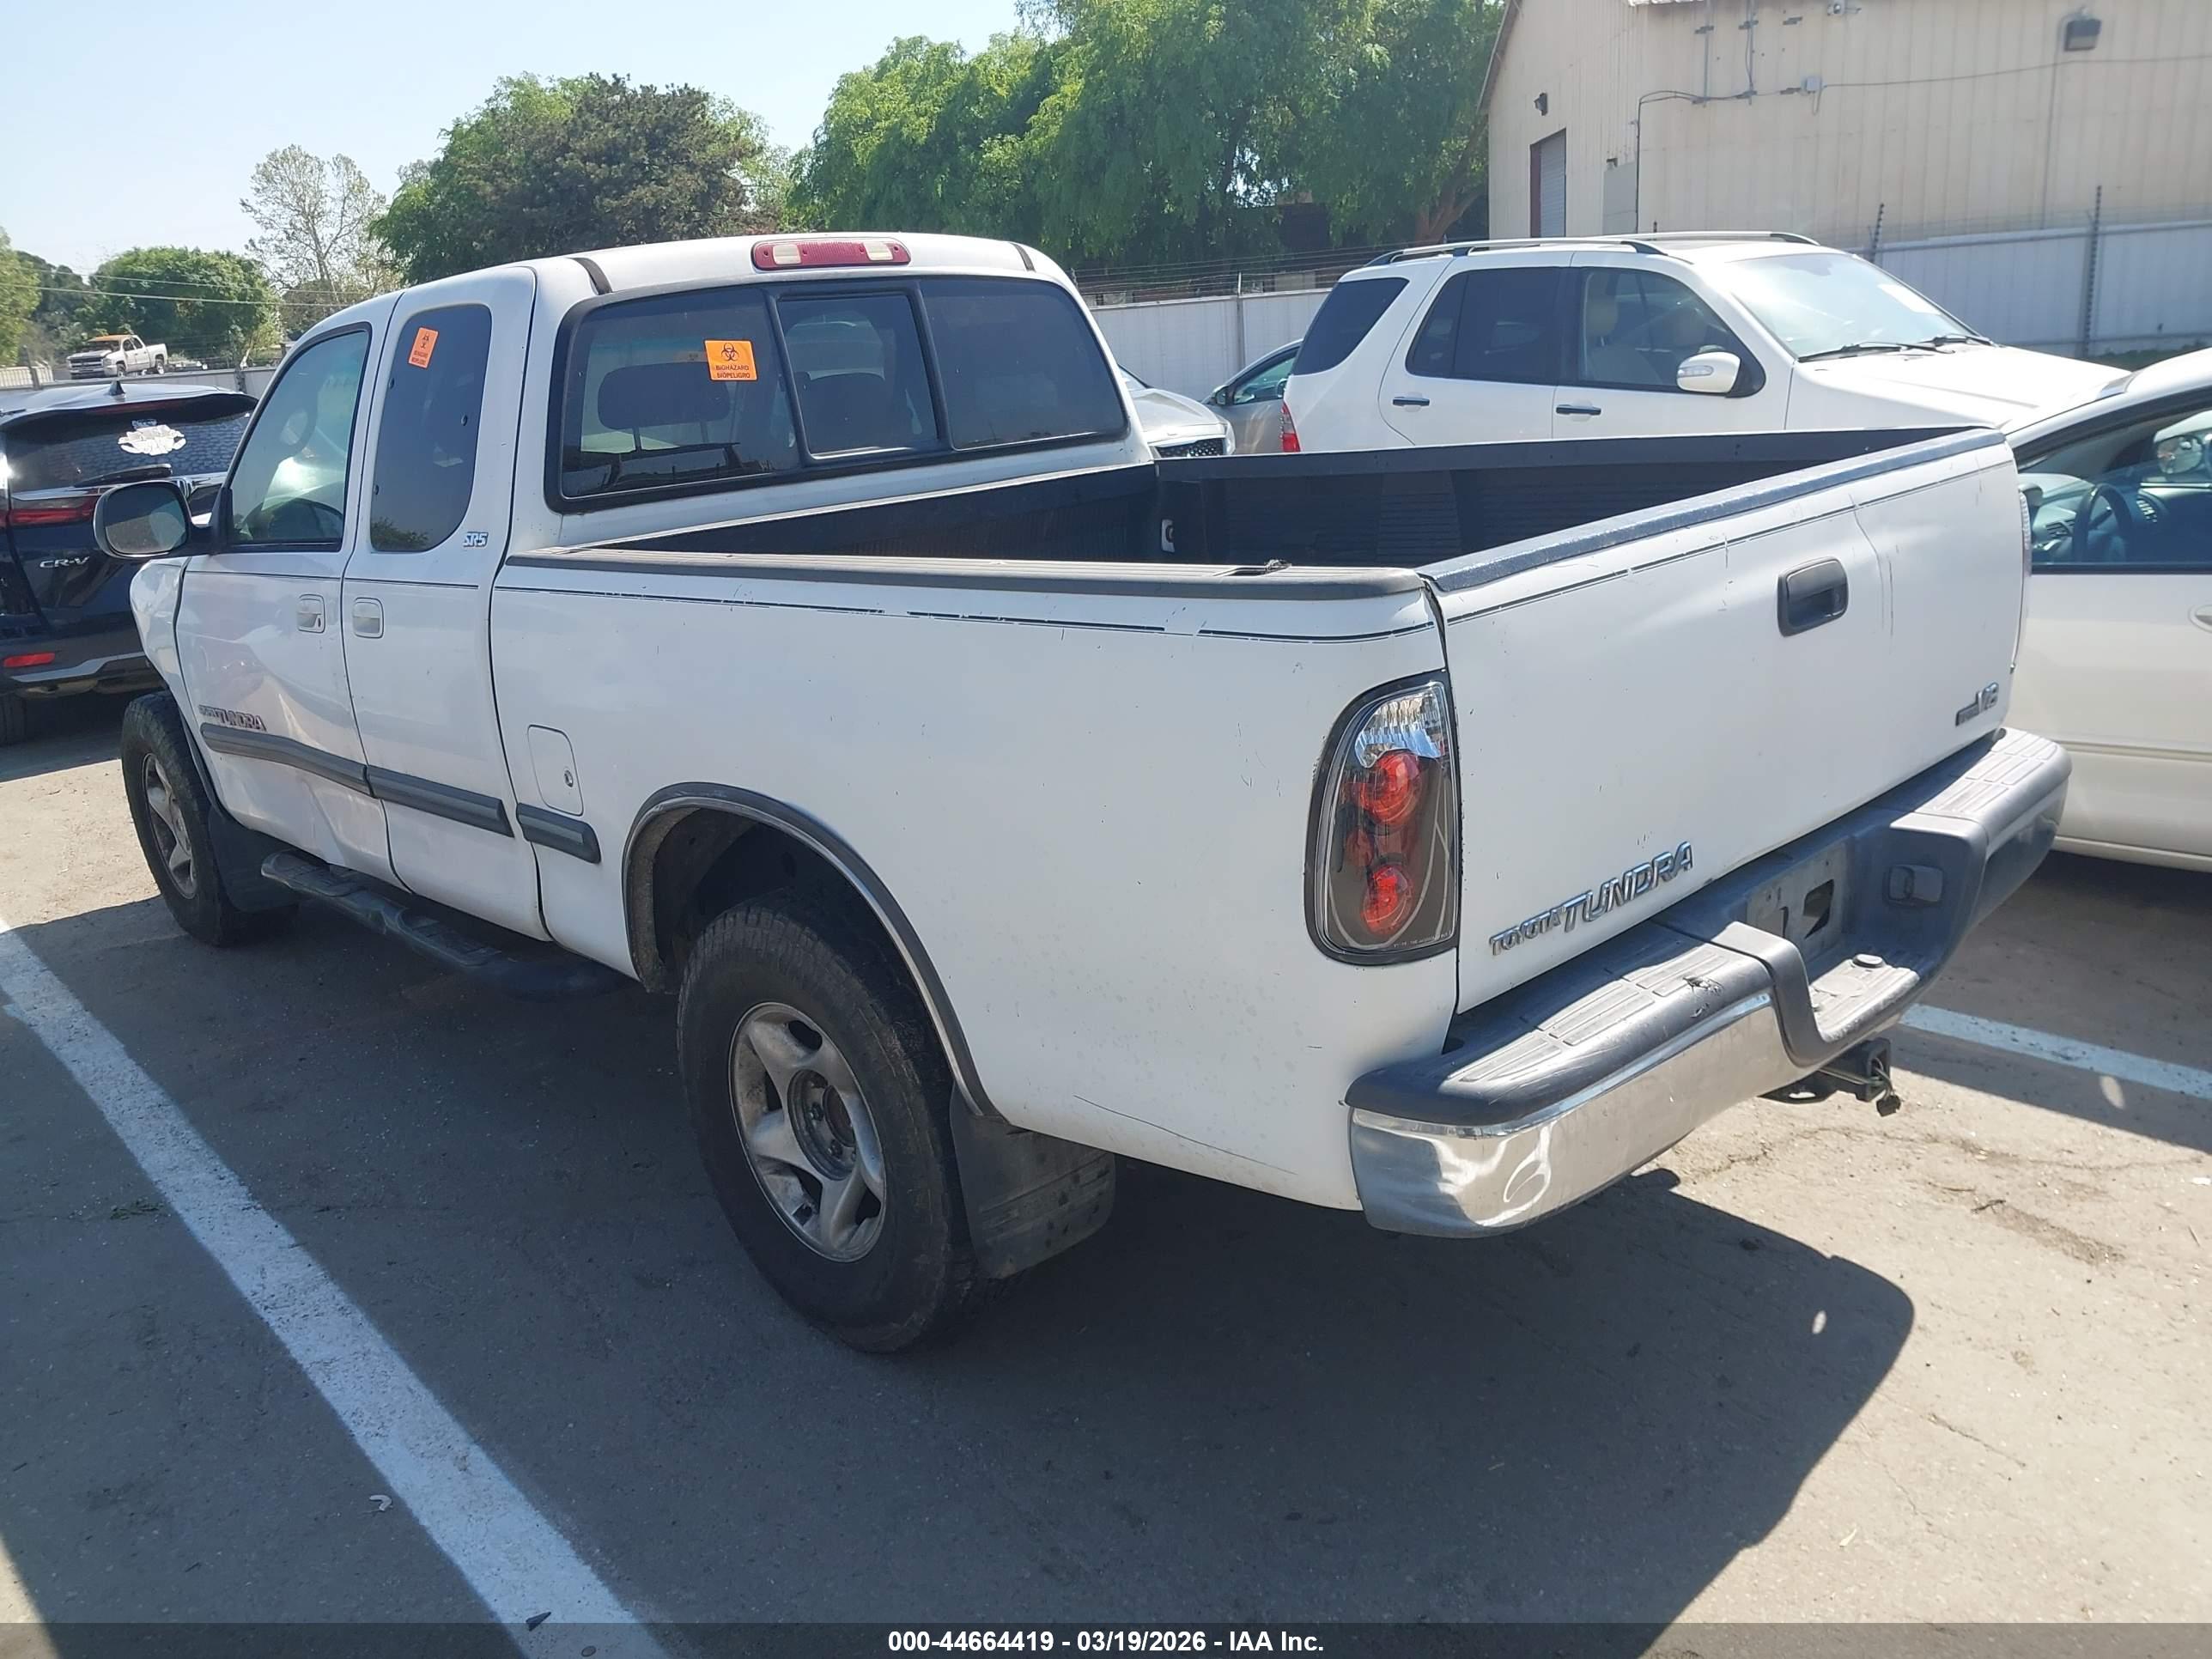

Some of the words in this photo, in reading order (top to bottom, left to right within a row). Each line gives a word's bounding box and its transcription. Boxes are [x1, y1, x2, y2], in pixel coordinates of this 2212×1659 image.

[463, 531, 489, 548] SR5
[40, 556, 90, 568] CR-V
[216, 708, 267, 732] TUNDRA
[1489, 905, 1562, 957] TOYOTA
[1559, 841, 1694, 933] TUNDRA
